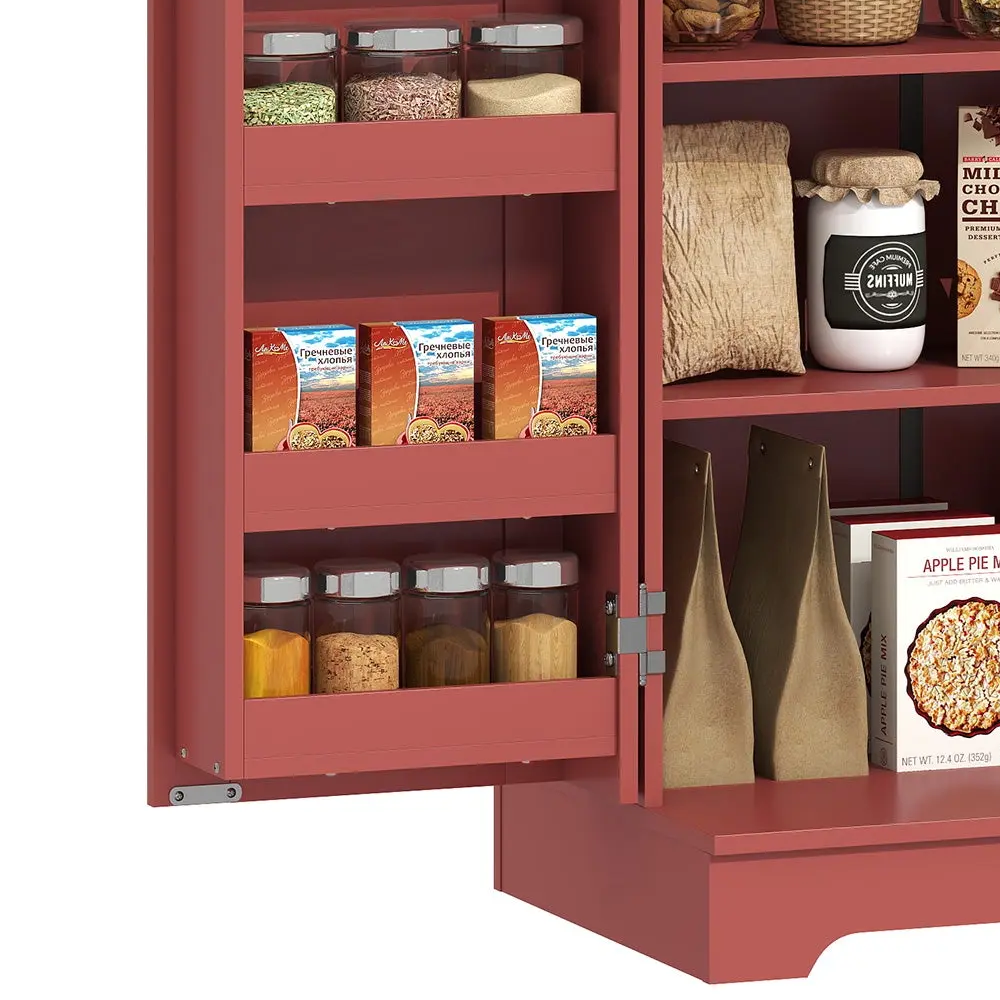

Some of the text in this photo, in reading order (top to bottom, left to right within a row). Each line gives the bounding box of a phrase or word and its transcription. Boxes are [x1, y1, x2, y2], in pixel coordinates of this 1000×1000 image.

[418, 341, 471, 354] Гречневые
[542, 336, 594, 347] Гречневые
[300, 347, 353, 359] Гречневые
[436, 351, 471, 359] хлопья
[559, 345, 594, 353] хлопья
[317, 356, 352, 365] хлопья
[923, 557, 964, 573] APPLE
[969, 555, 989, 570] PIE
[880, 692, 888, 736] APPLE
[901, 757, 917, 766] NET
[936, 754, 952, 764] 12.4
[968, 752, 992, 763] (352g)
